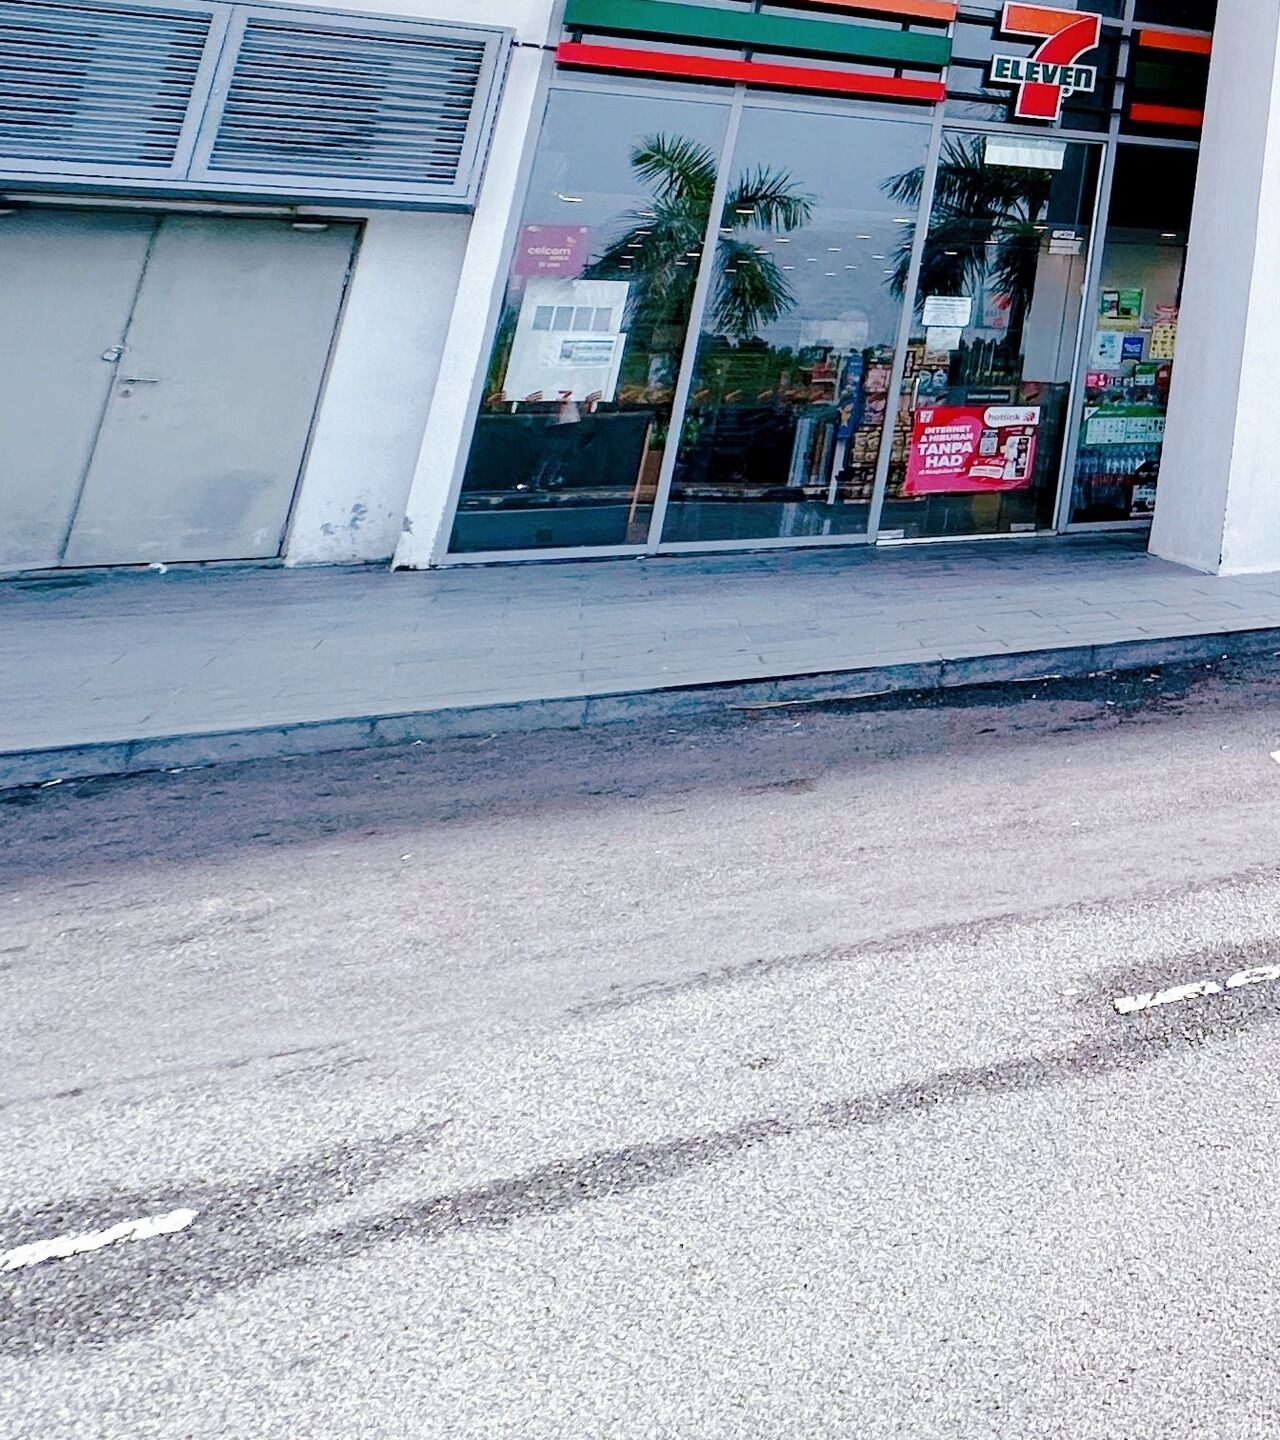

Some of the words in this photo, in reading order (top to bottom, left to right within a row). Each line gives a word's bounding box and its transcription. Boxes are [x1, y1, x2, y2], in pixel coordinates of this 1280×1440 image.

[527, 245, 571, 256] celcom
[924, 425, 972, 435] INTERNET
[929, 433, 974, 441] HIBURAN
[918, 442, 973, 456] TANPA
[925, 455, 963, 468] HAD
